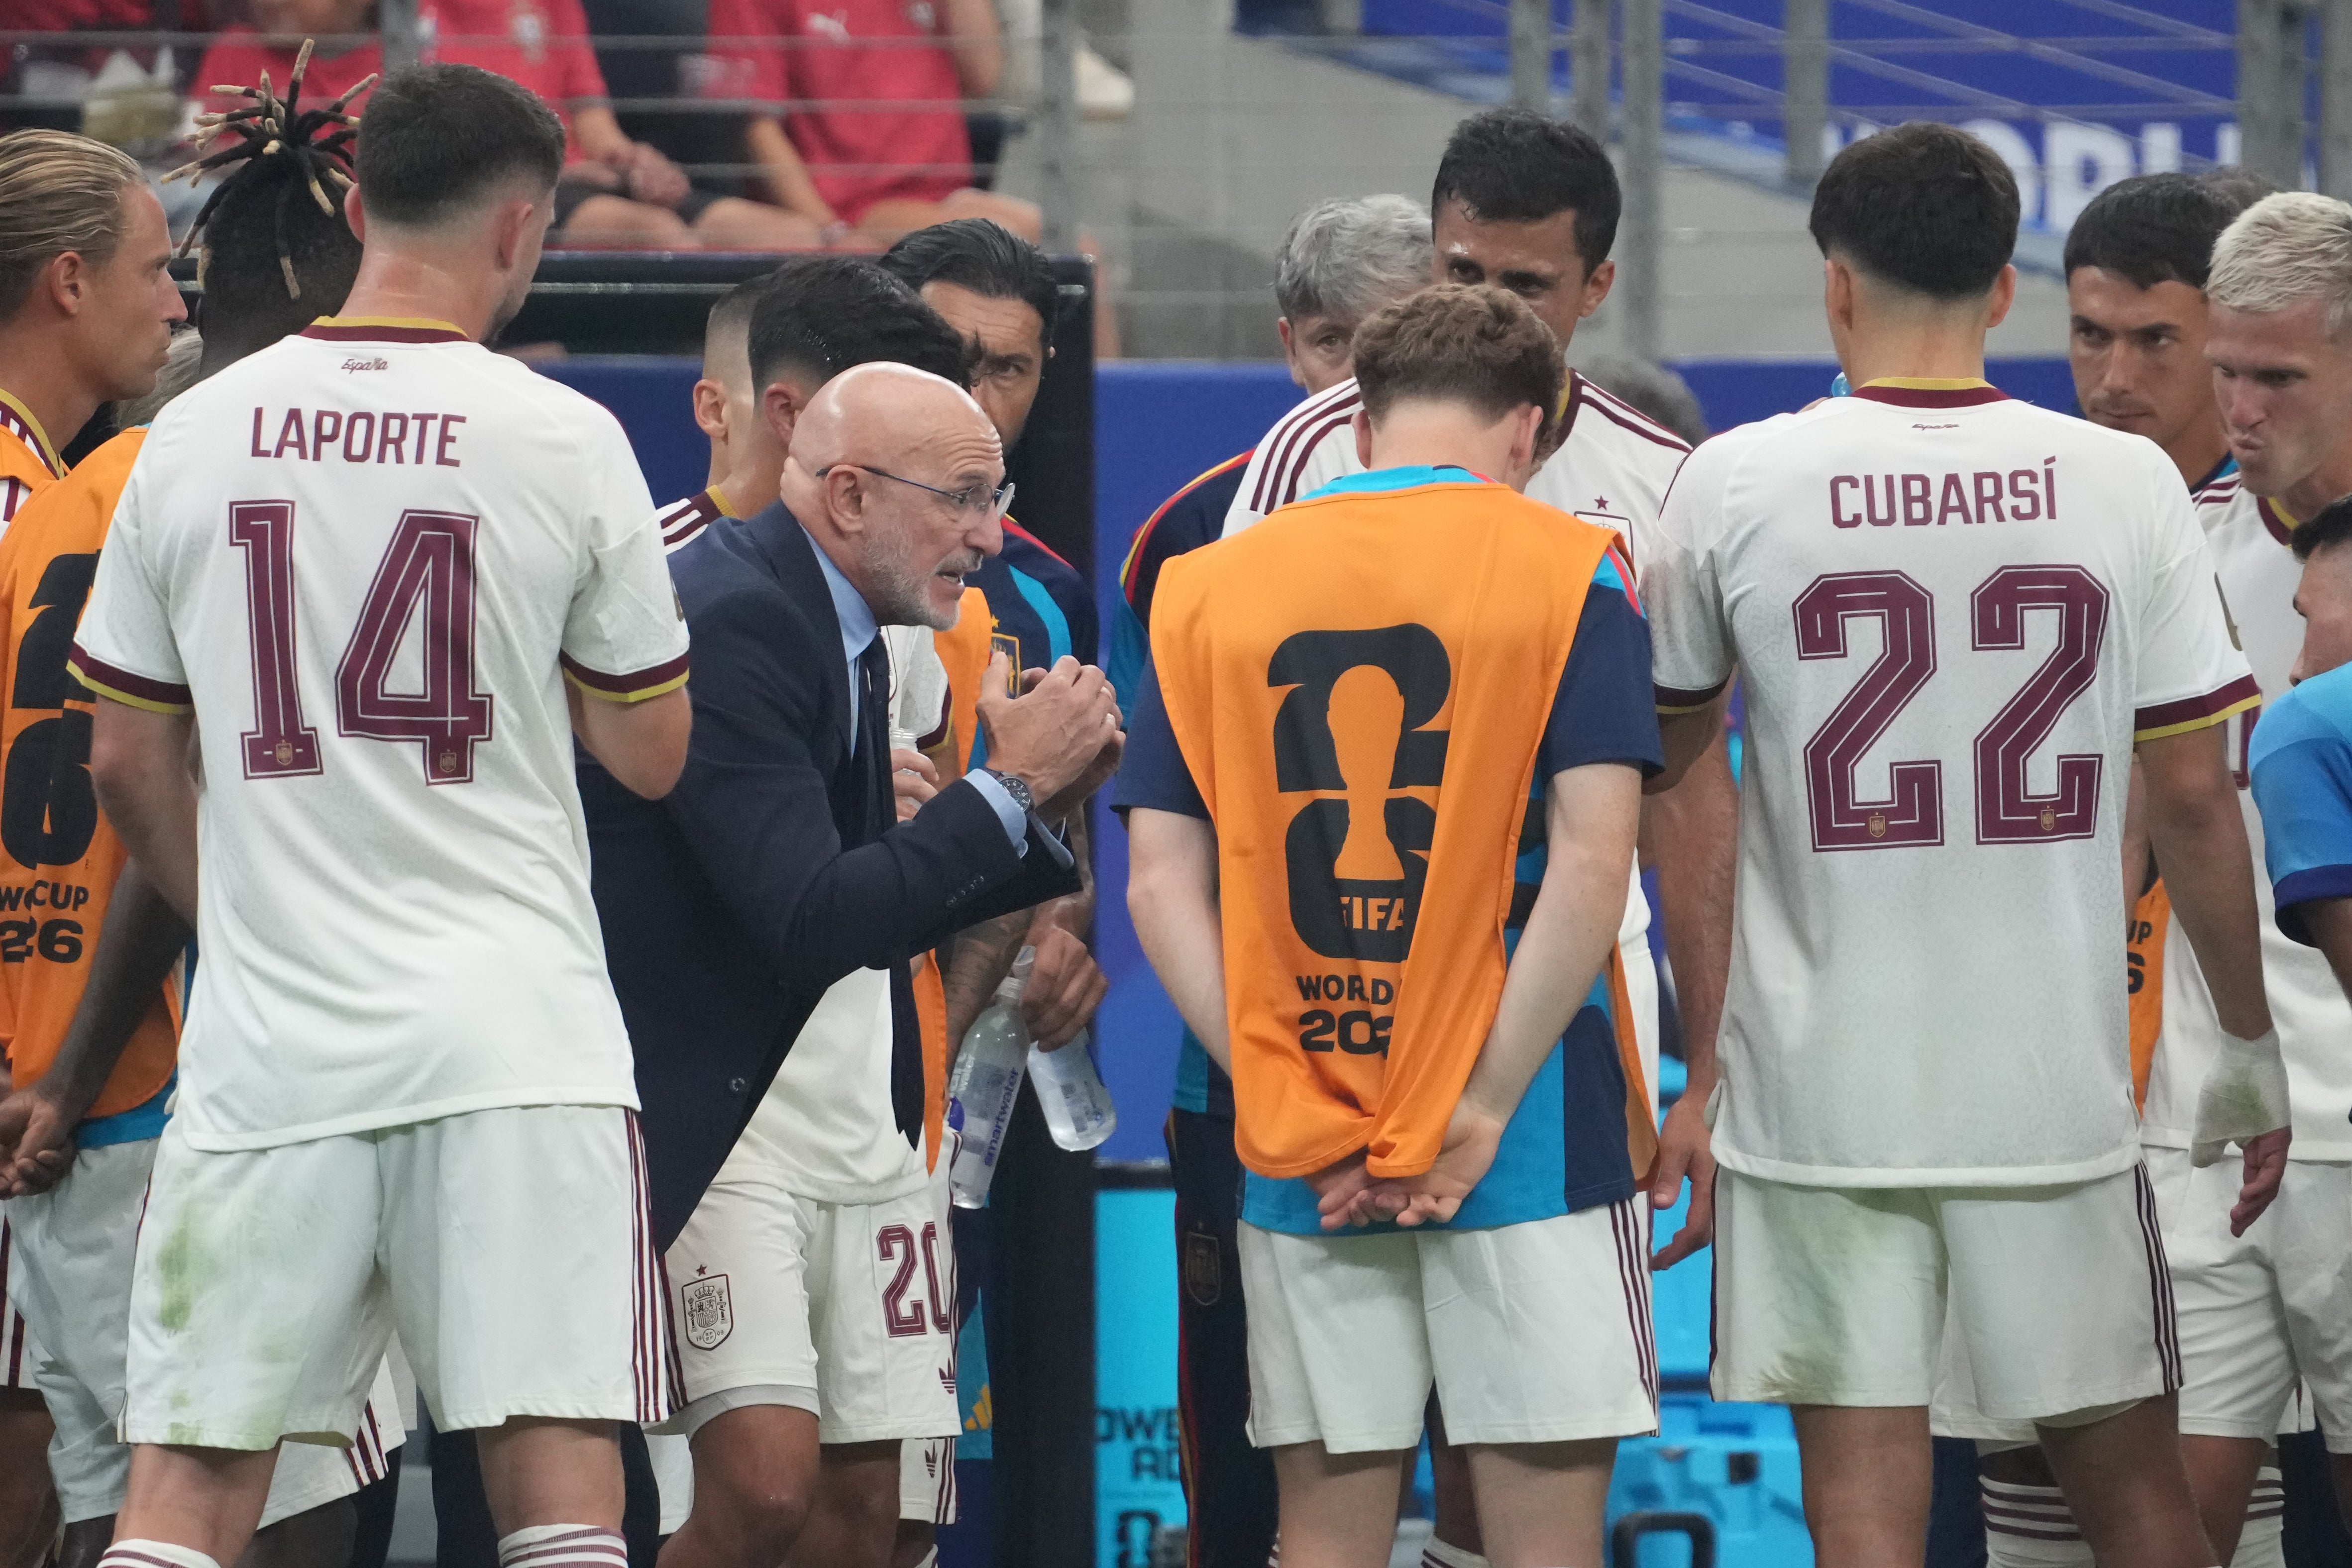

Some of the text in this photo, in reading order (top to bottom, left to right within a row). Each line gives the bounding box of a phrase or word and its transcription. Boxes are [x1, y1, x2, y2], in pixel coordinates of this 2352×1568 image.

[252, 408, 466, 466] LAPORTE
[1830, 457, 2056, 528] CUBARSÍ
[229, 499, 493, 786] 14
[1792, 564, 2110, 852] 22
[1295, 974, 1394, 1006] WORD
[876, 1221, 951, 1339] 20
